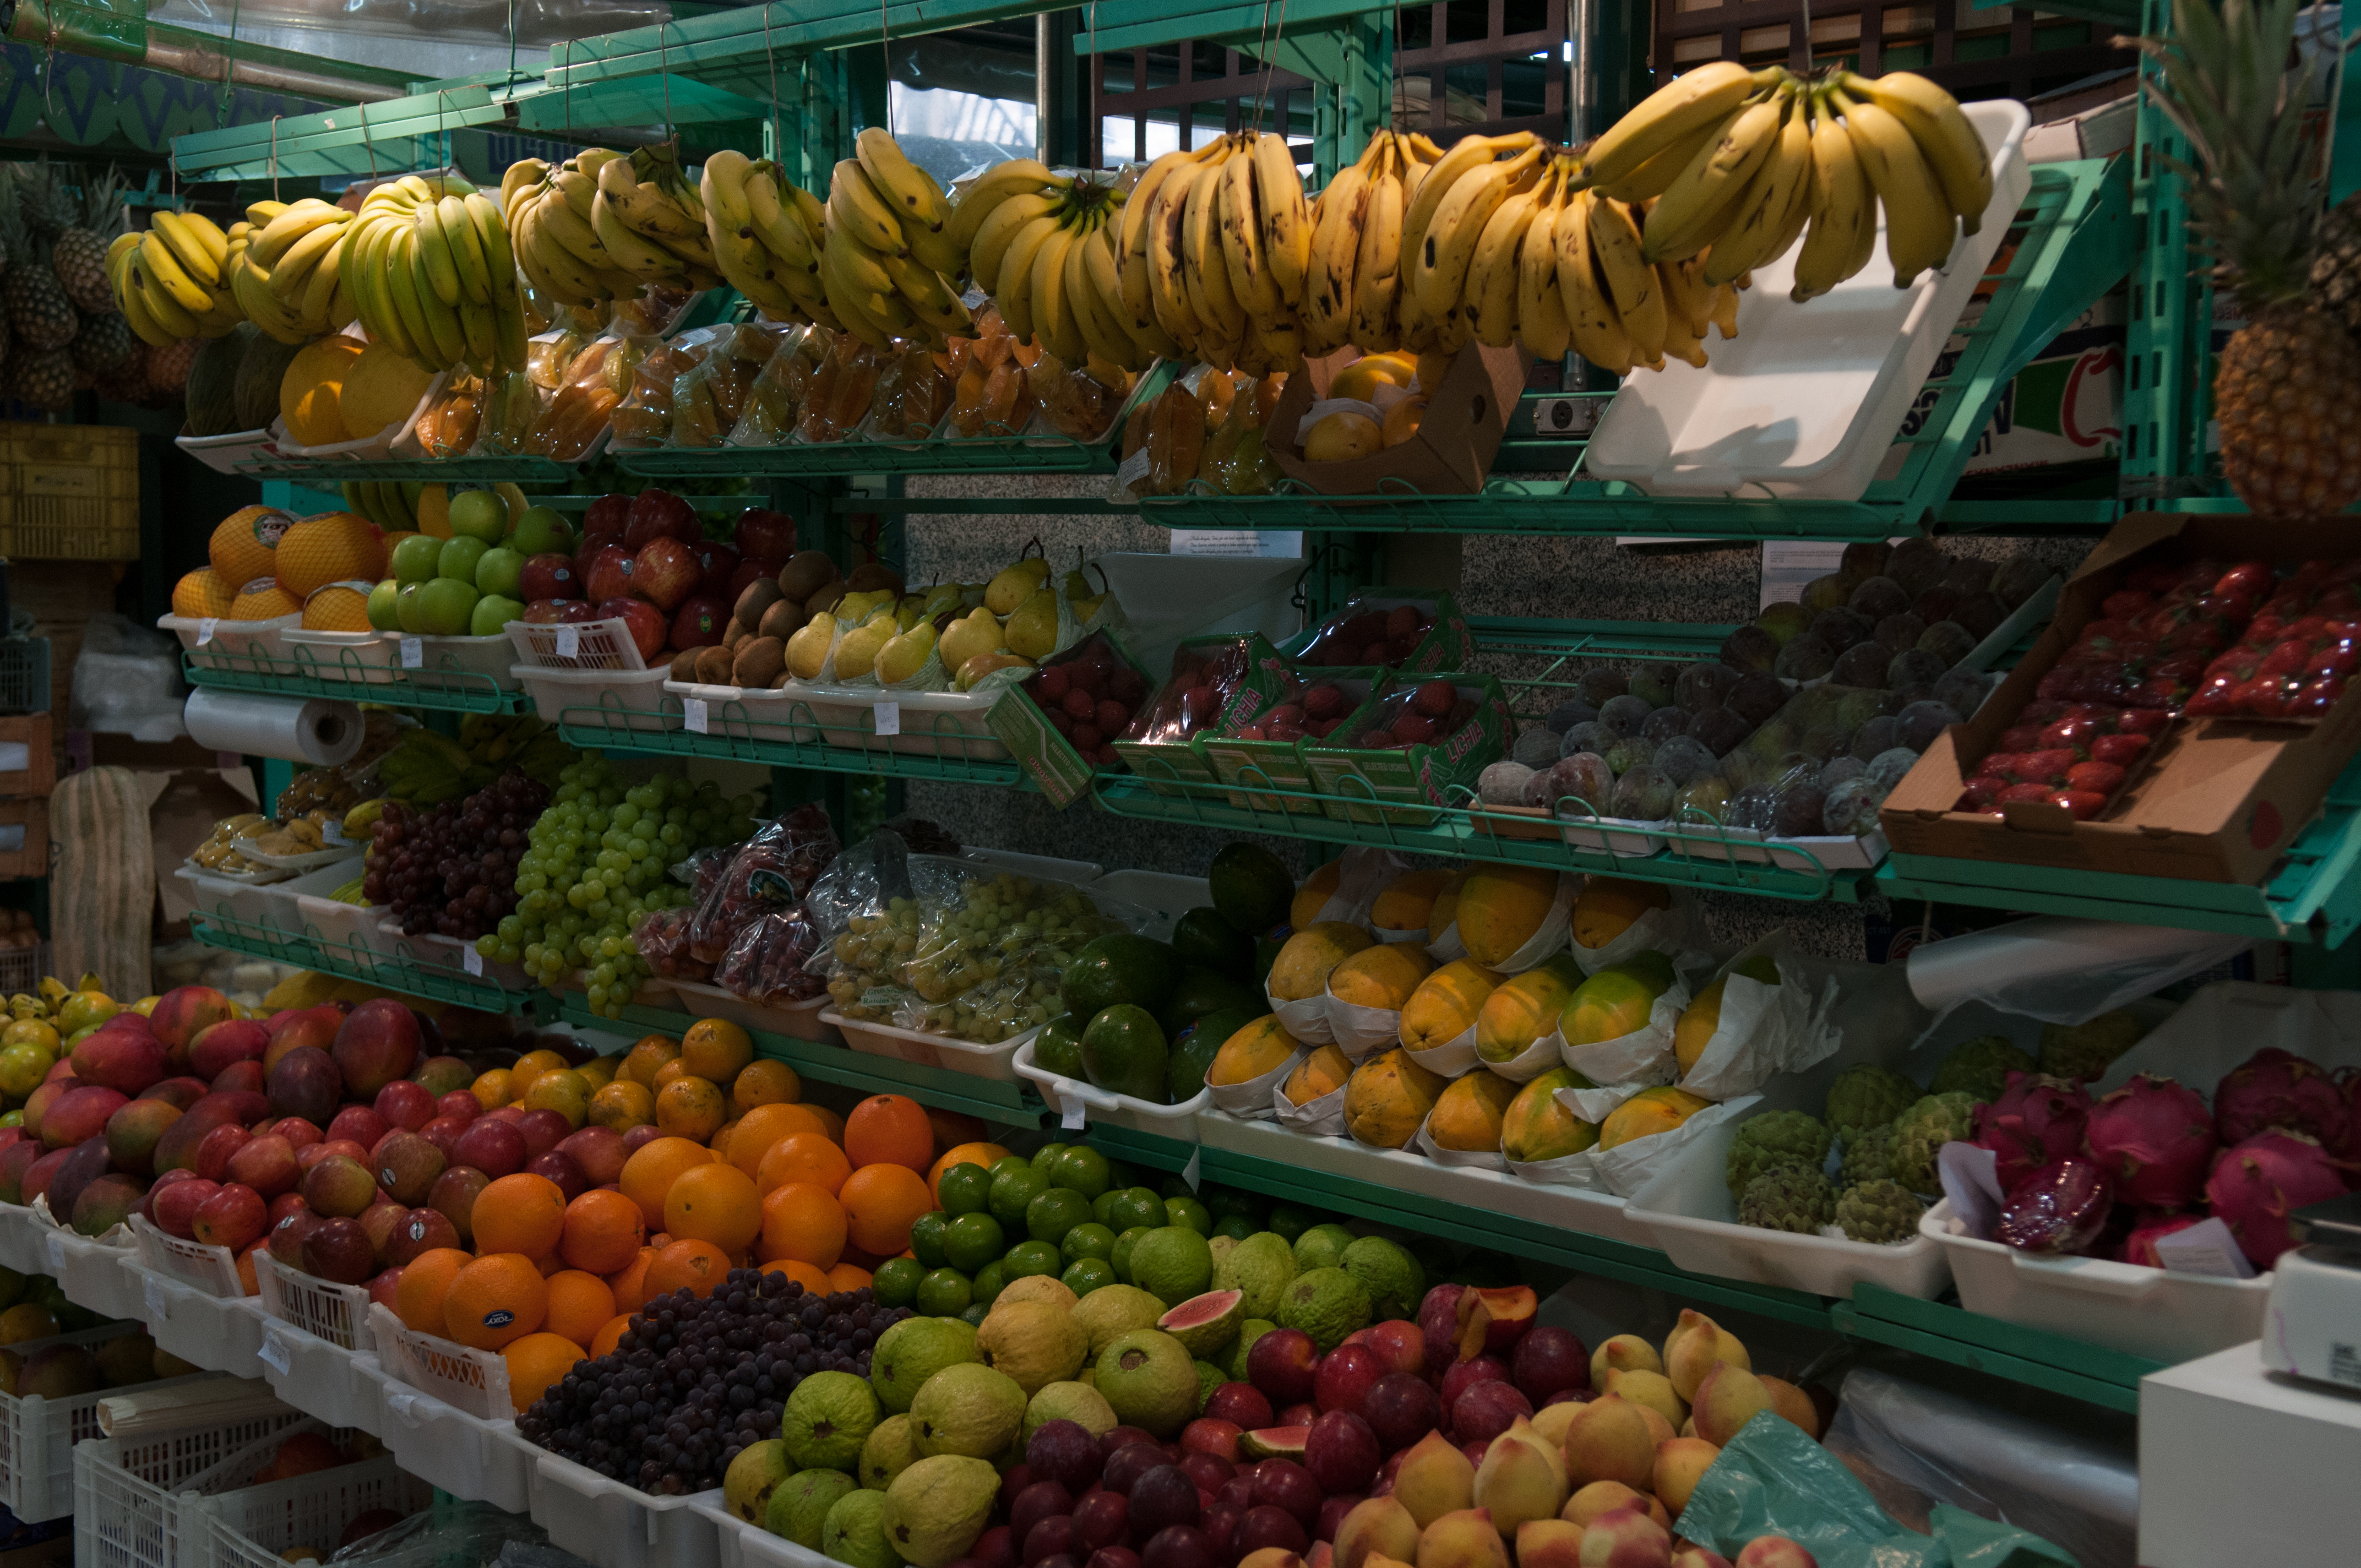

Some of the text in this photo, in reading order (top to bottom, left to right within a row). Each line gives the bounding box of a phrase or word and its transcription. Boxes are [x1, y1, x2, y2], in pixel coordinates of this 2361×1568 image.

[1048, 741, 1071, 767] SELECTED
[1445, 719, 1486, 765] LICHIA
[1025, 754, 1069, 804] Okayama
[1362, 761, 1389, 771] SELECTED
[485, 1315, 513, 1325] ROXY
